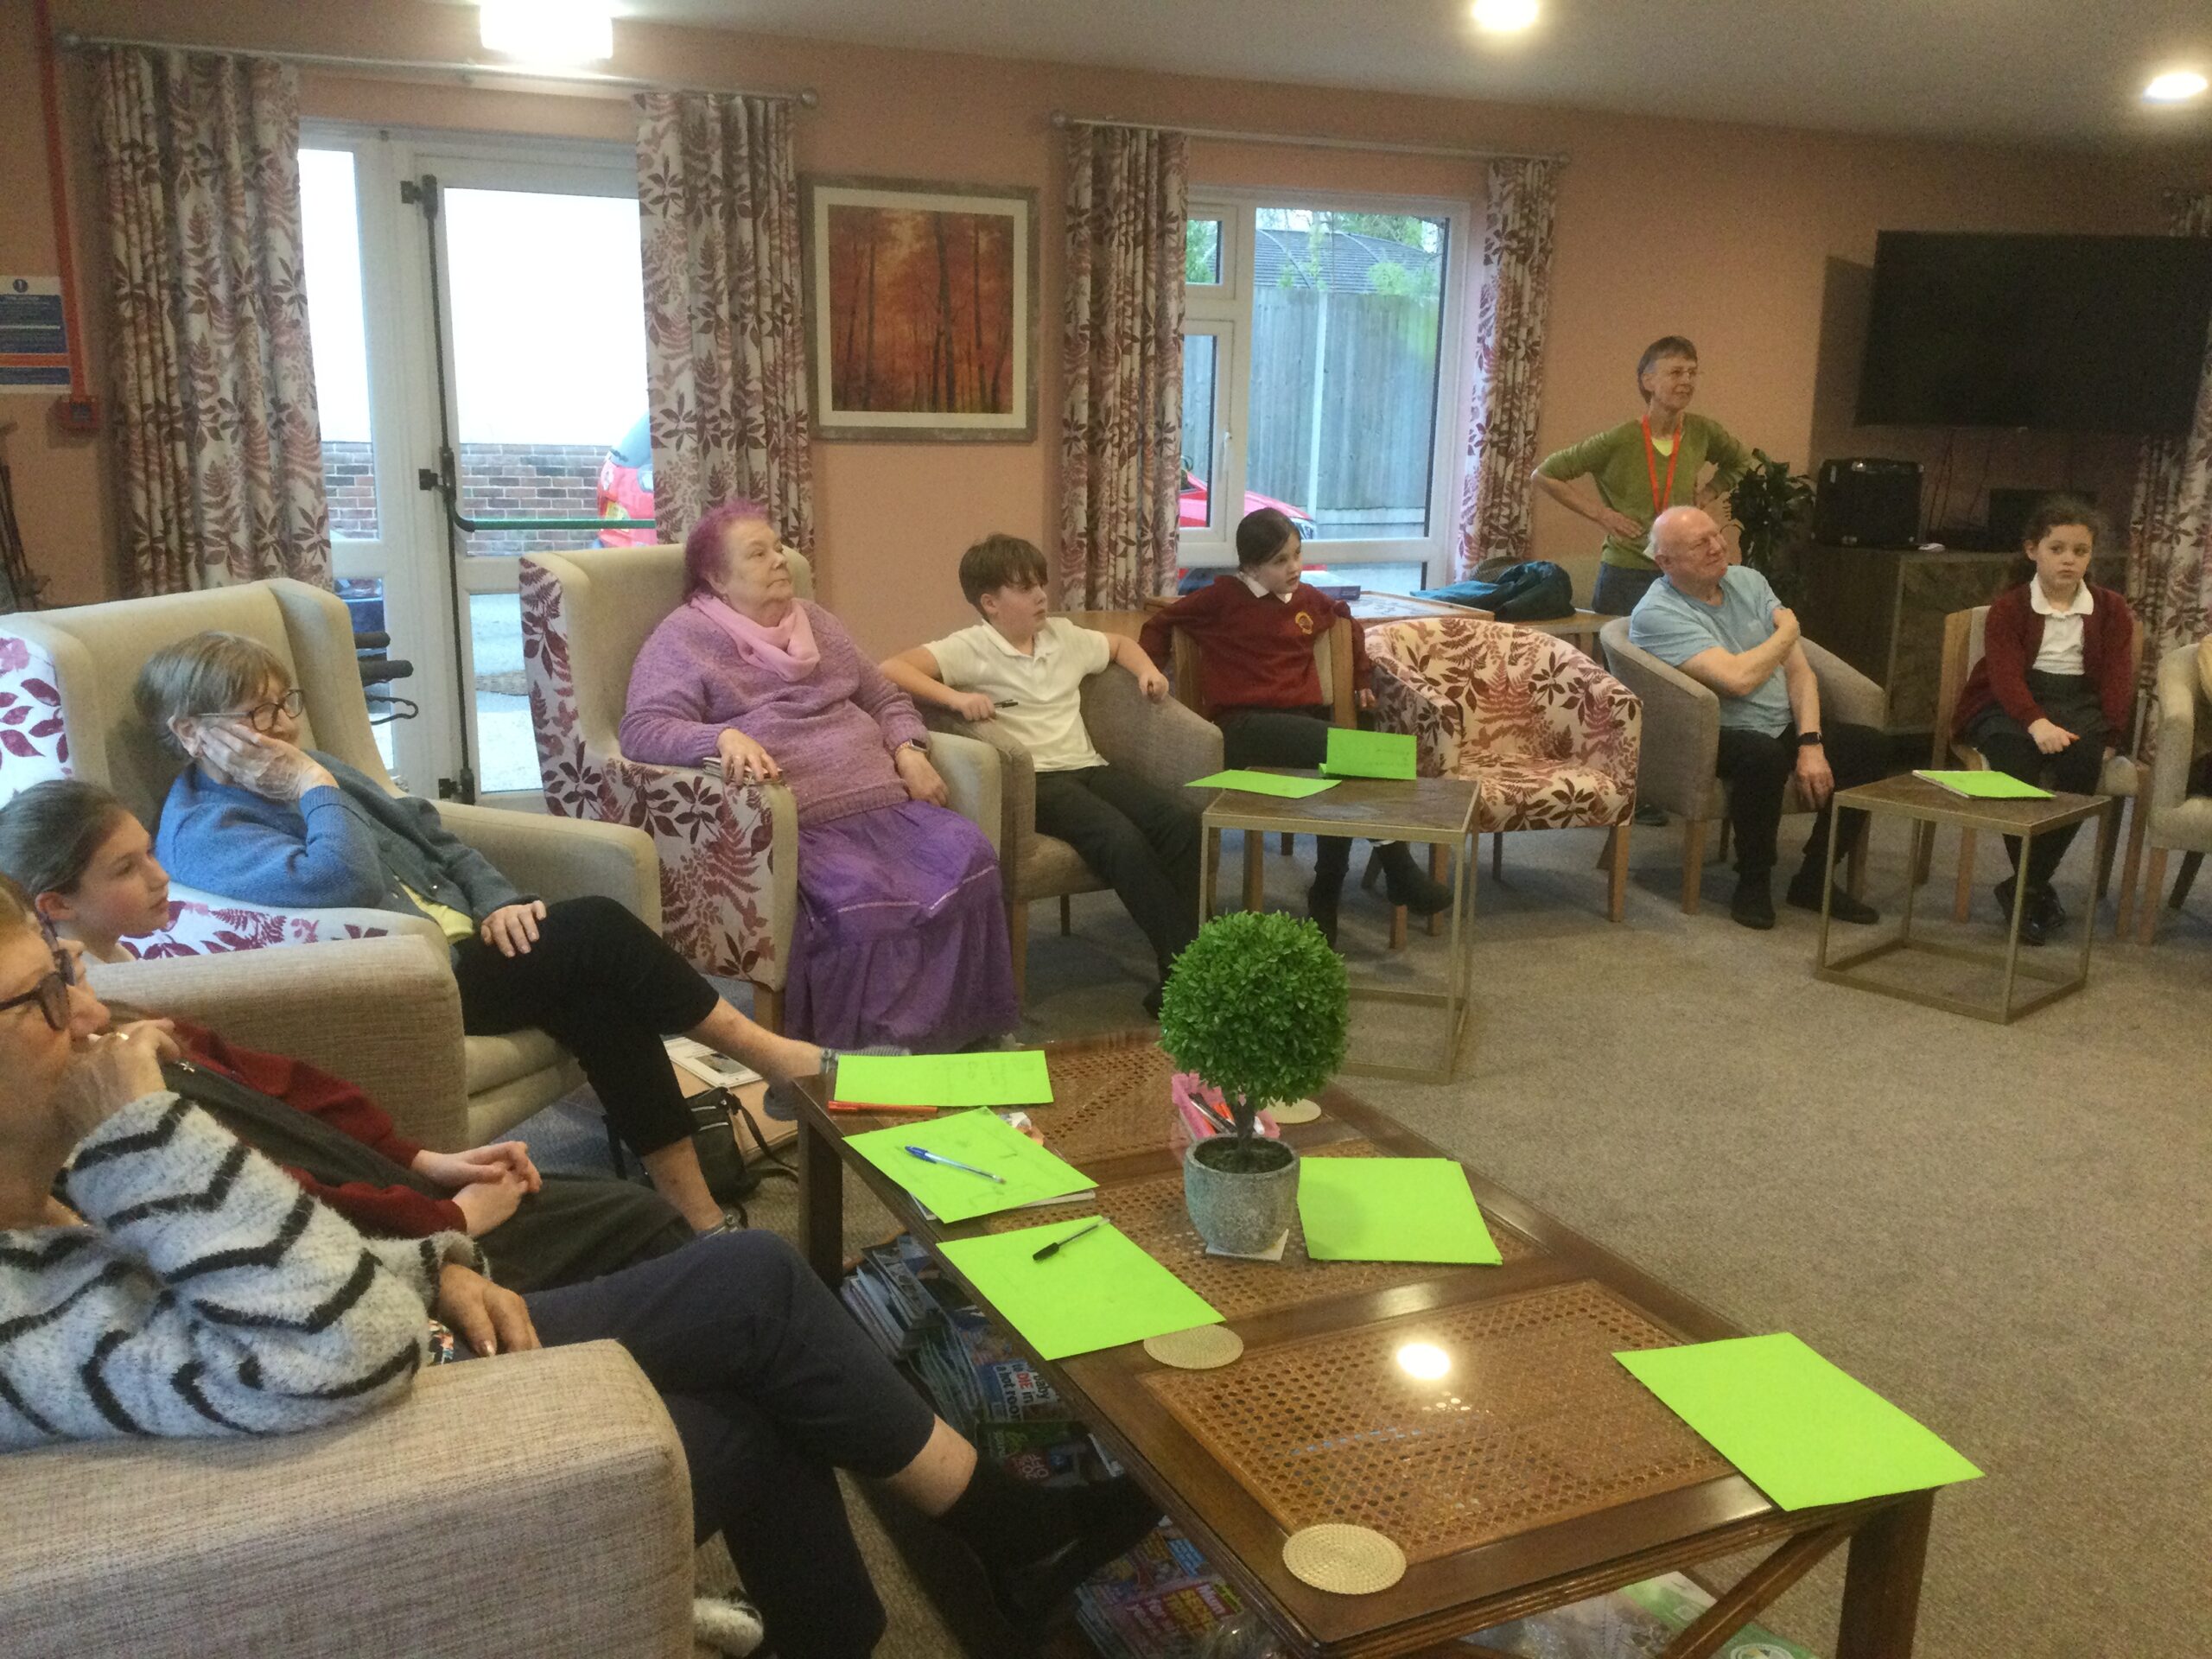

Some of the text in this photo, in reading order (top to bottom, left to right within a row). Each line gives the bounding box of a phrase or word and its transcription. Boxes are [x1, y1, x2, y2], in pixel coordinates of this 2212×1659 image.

[999, 1371, 1015, 1389] hot
[1016, 1372, 1033, 1389] DIE
[1021, 1390, 1035, 1403] in
